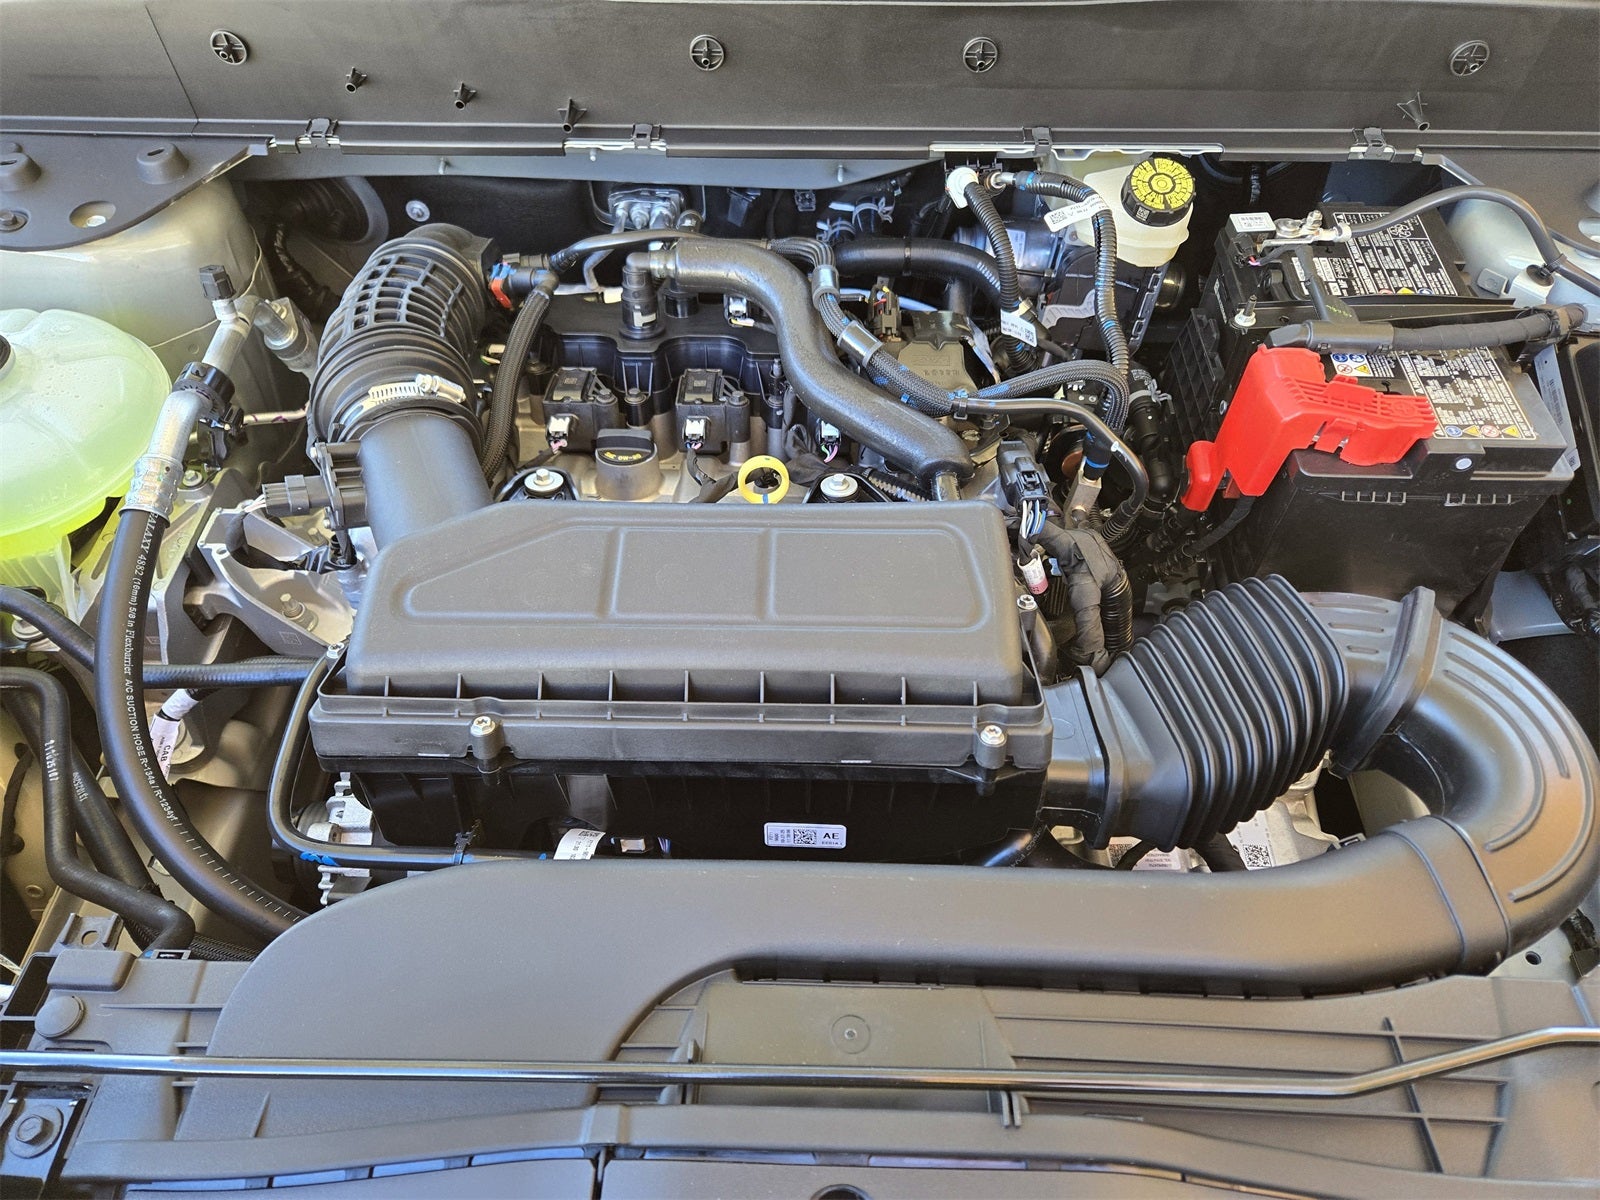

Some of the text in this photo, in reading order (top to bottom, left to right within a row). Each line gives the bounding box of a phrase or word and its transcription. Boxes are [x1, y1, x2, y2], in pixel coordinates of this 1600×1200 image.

[135, 555, 146, 576] 4882
[130, 578, 141, 606] (16mm)
[128, 606, 137, 619] 5/8
[123, 629, 136, 676] Flexbarrier
[125, 678, 134, 694] A/C
[126, 694, 140, 732] SUCTION
[132, 732, 146, 757] HOSE
[160, 745, 172, 762] CAB
[140, 757, 156, 786] R-134a
[822, 832, 840, 840] AE
